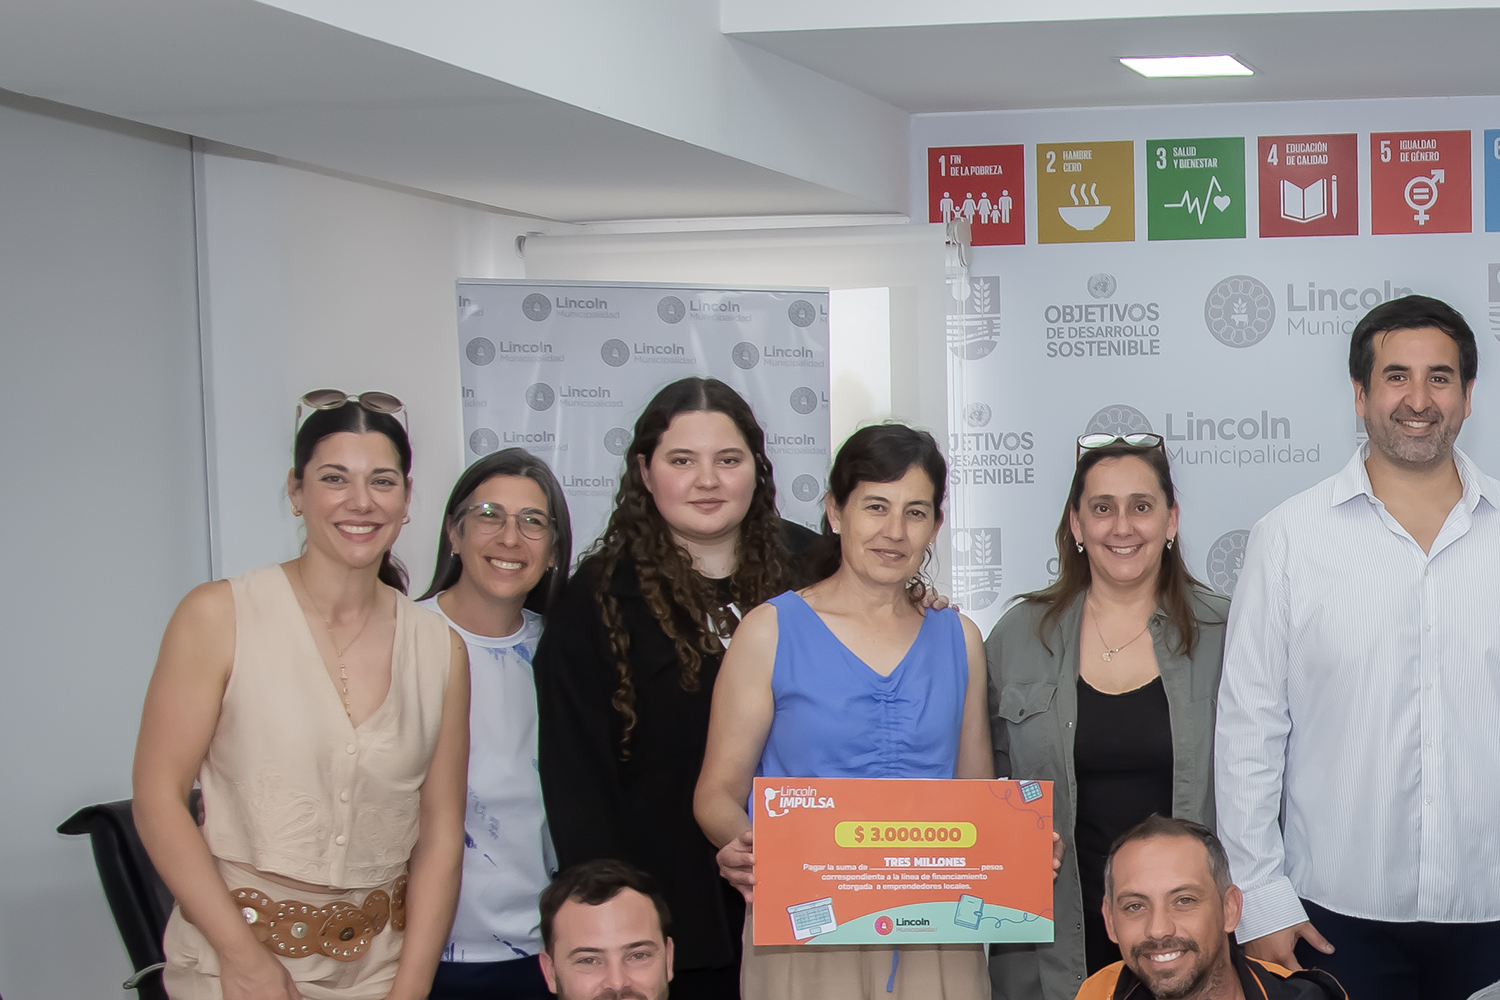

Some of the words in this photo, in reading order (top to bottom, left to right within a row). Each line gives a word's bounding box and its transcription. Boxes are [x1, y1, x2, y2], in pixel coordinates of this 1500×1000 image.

[1286, 141, 1327, 153] EDUCACIÓN
[1400, 139, 1436, 150] IGUALDAD
[1063, 150, 1092, 160] HAMBRE
[1173, 146, 1196, 157] SALUD
[1267, 144, 1278, 166] 4
[1381, 140, 1392, 162] 5
[1400, 152, 1410, 162] DE
[1411, 150, 1439, 162] GÉNERO
[950, 154, 961, 164] FIN
[1046, 151, 1056, 173] 2
[1156, 147, 1166, 169] 3
[1179, 157, 1218, 169] BIENESTAR
[1286, 156, 1296, 166] DE
[1297, 155, 1328, 165] CALIDAD
[939, 155, 945, 176] 1
[950, 167, 960, 177] DE
[960, 166, 970, 176] LA
[970, 165, 1003, 175] POBREZA
[1063, 162, 1082, 172] CERO
[556, 296, 608, 310] Lincoln
[690, 299, 741, 313] Lincoln
[1044, 302, 1160, 324] OBJETIVOS
[1046, 326, 1065, 339] DE
[1068, 324, 1160, 339] DESARROLLO
[500, 341, 552, 353] Lincoln
[634, 342, 684, 355] Lincoln
[763, 346, 813, 358] Lincoln
[1046, 339, 1160, 358] SOSTENIBLE
[559, 386, 611, 398] Lincoln
[1165, 410, 1291, 440] Lincoln
[503, 430, 555, 443] Lincoln
[766, 433, 815, 445] Lincoln
[1168, 443, 1320, 468] Municipalidad
[562, 474, 614, 487] Lincoln
[780, 786, 817, 797] Lincoln
[779, 797, 835, 809] IMPULSA
[854, 825, 864, 843] $
[870, 827, 961, 842] 3.000.000
[803, 864, 826, 872] Pagar
[884, 857, 911, 867] TRES
[914, 857, 966, 867] MILLONES
[821, 872, 885, 881] correspondiente
[932, 872, 988, 881] financiamiento
[837, 883, 873, 892] otorgada
[883, 883, 943, 891] emprendedores
[896, 918, 930, 926] Lincoln
